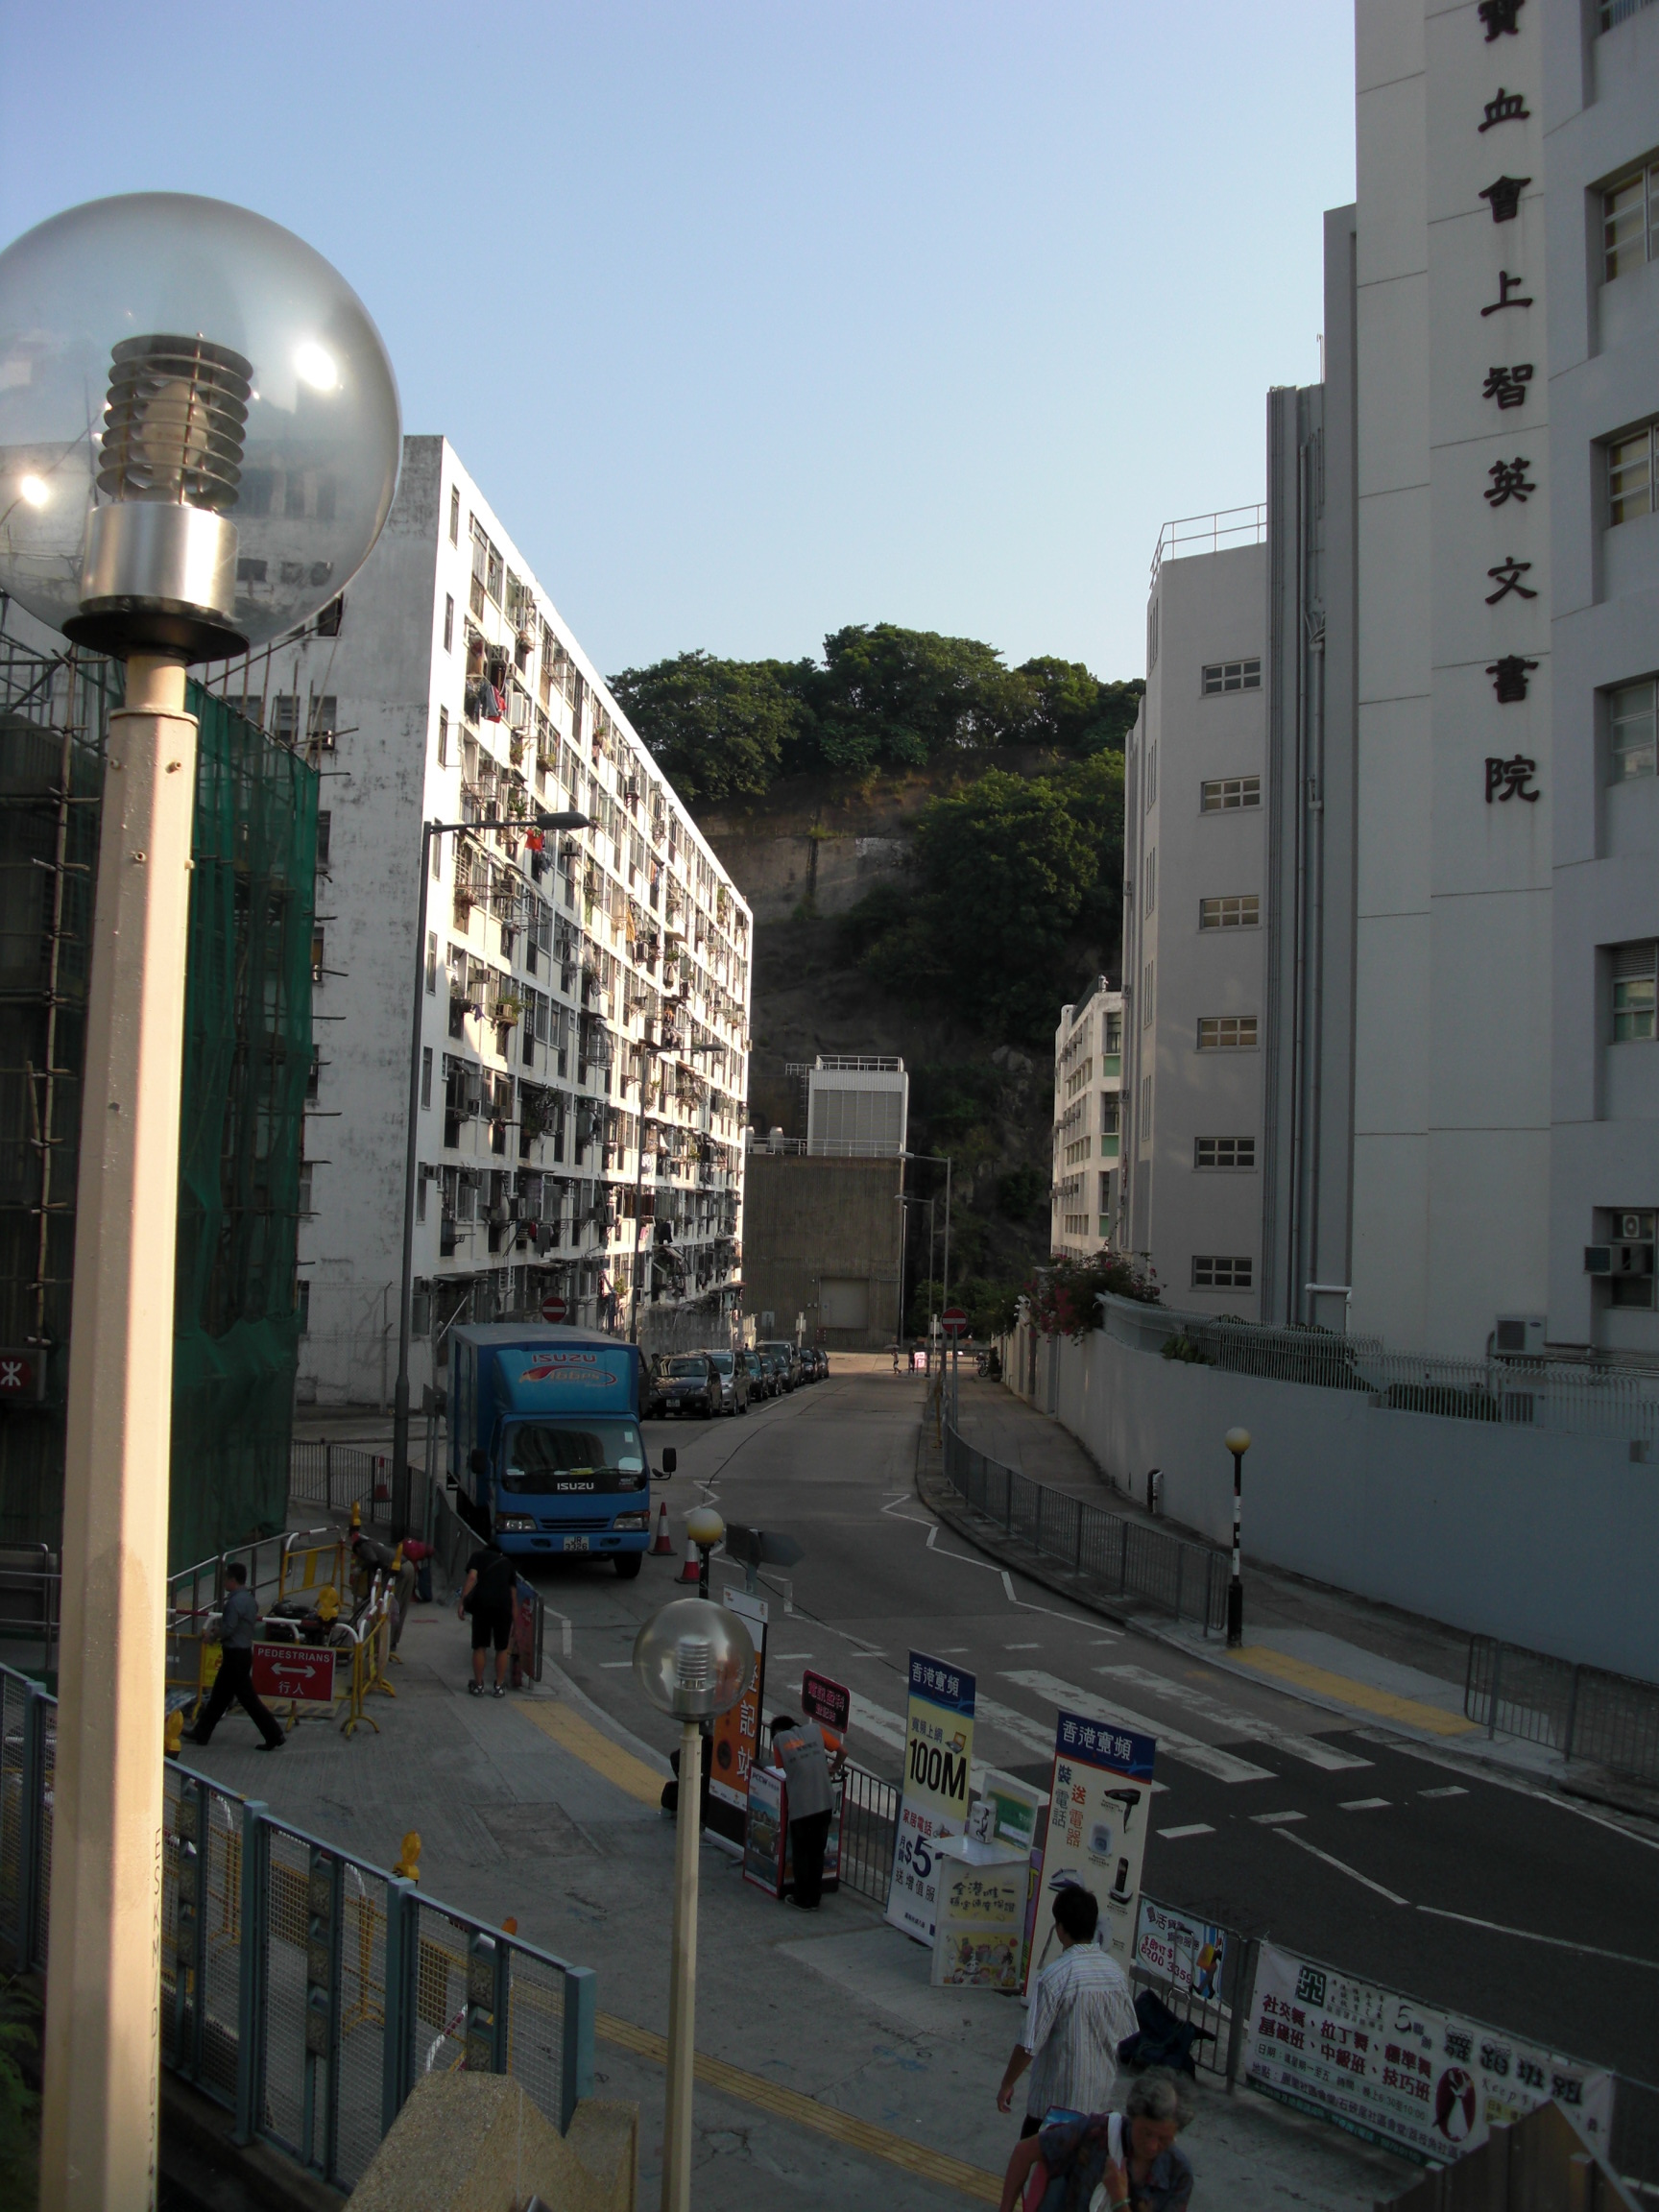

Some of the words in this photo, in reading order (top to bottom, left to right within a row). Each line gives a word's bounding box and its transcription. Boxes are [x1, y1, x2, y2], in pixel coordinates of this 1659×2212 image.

[532, 1354, 597, 1363] ISUZU
[257, 1647, 331, 1664] PEDESTRIANS
[277, 1681, 304, 1695] 行人
[911, 1662, 960, 1697] 香港寬頻
[911, 1717, 944, 1743] 寬頻上網
[1062, 1719, 1133, 1761] 香港寬頻
[909, 1739, 967, 1801] 100M
[902, 1809, 933, 1837] 家居電話
[1066, 1784, 1087, 1848] 送電器
